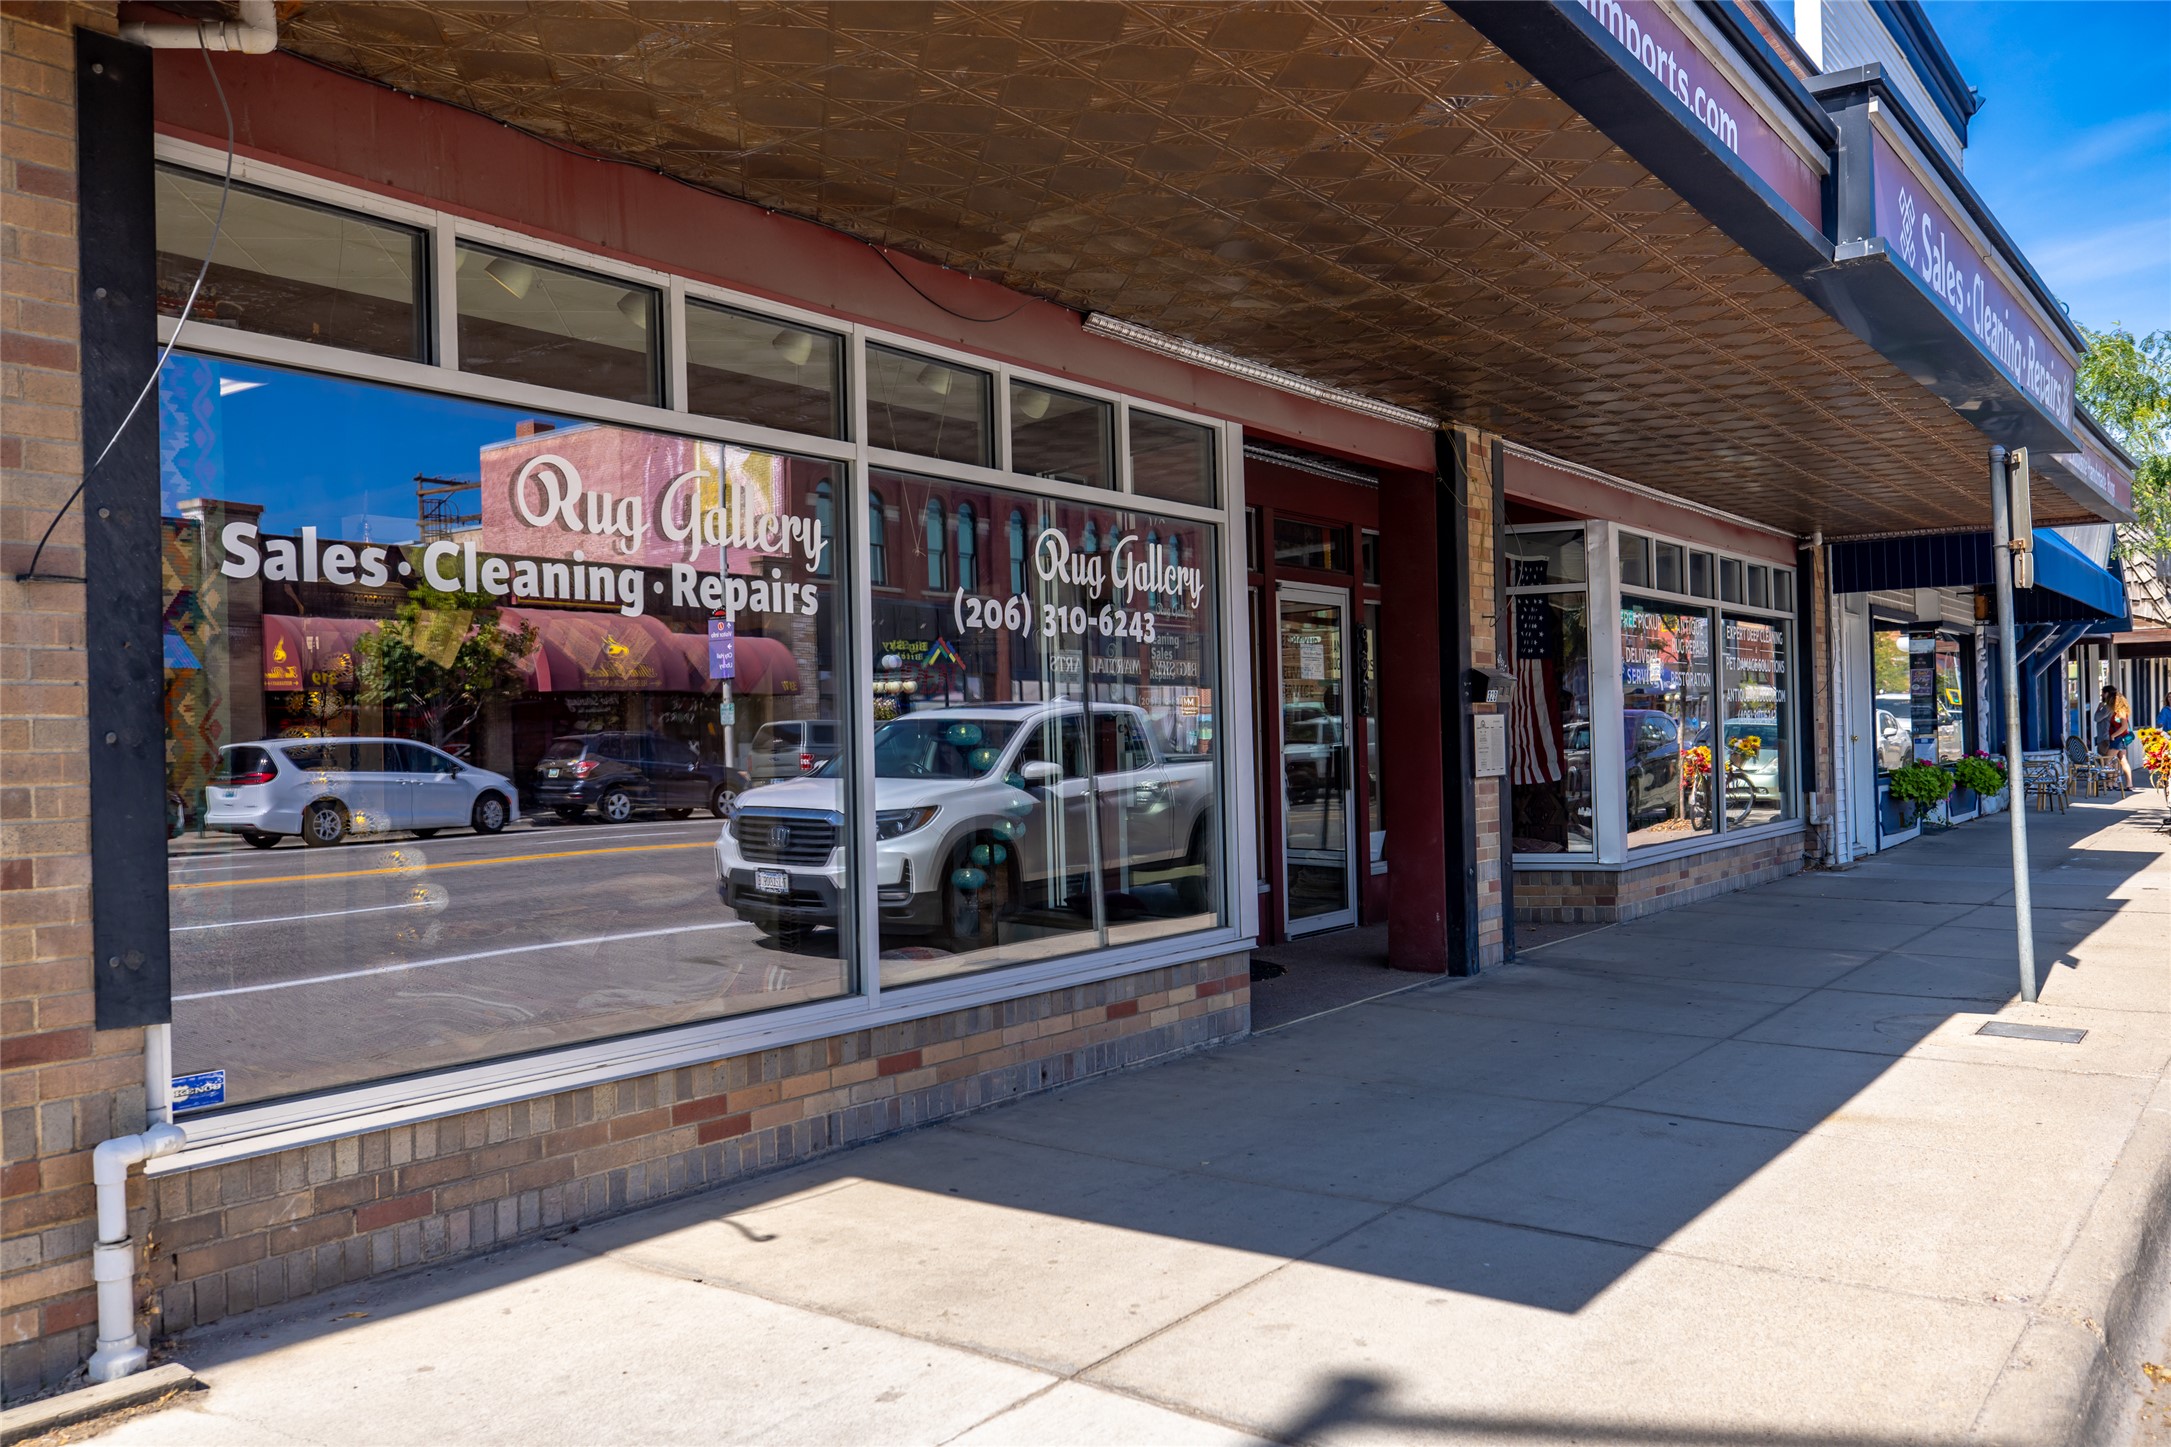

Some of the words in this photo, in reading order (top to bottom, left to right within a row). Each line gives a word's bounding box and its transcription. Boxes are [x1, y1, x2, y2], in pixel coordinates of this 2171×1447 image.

[1922, 213, 1964, 314] Sales
[1973, 273, 2021, 383] Cleaning
[2027, 335, 2063, 416] Repairs
[517, 454, 649, 555] Rug
[661, 470, 829, 572] Gallery
[220, 521, 389, 588] Sales
[423, 550, 645, 617] Cleaning
[672, 563, 818, 622] Repairs
[1035, 528, 1106, 599] Rug
[1111, 535, 1204, 609] Gallery
[954, 586, 1032, 639] (206)
[1043, 604, 1156, 643] 310-6243
[1620, 609, 1636, 628] FREE
[1637, 612, 1661, 631] PICKUP
[1676, 618, 1704, 636] ANTIQUE
[1726, 625, 1746, 641] EXPERT
[1747, 627, 1759, 642] DEEP
[1760, 629, 1783, 645] CLEANING
[1153, 632, 1180, 649] eaning
[1671, 638, 1684, 654] RUG
[1685, 639, 1709, 655] REPAIRS
[1151, 647, 1173, 660] Sales
[1626, 647, 1658, 664] DELIVERY
[1725, 656, 1736, 671] PET
[1737, 657, 1759, 672] DAMAGE
[1759, 659, 1785, 674] SOLUTIONS
[1670, 671, 1711, 687] RESTORATION
